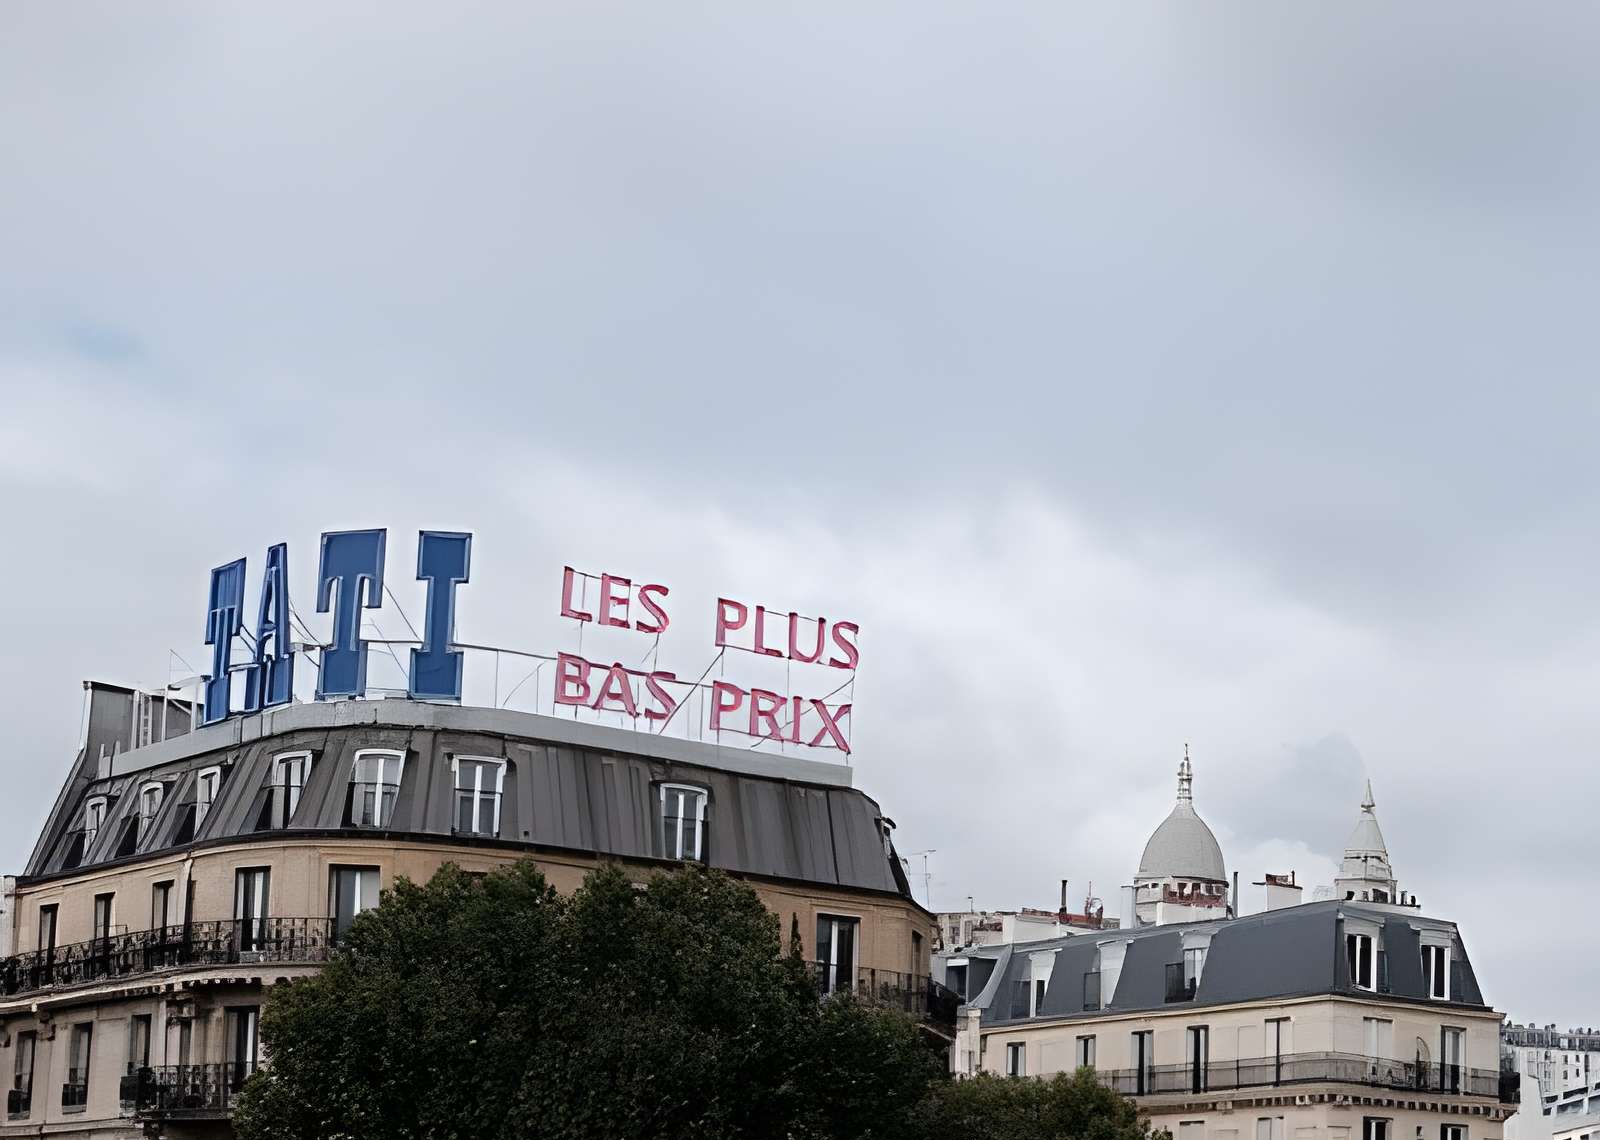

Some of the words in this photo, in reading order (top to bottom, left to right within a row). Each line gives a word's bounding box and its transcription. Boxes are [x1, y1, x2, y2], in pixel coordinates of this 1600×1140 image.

[202, 527, 473, 725] TATI
[560, 565, 671, 634] LES
[714, 597, 860, 670] PLUS
[553, 651, 677, 720] BAS
[710, 680, 852, 755] PRIX
